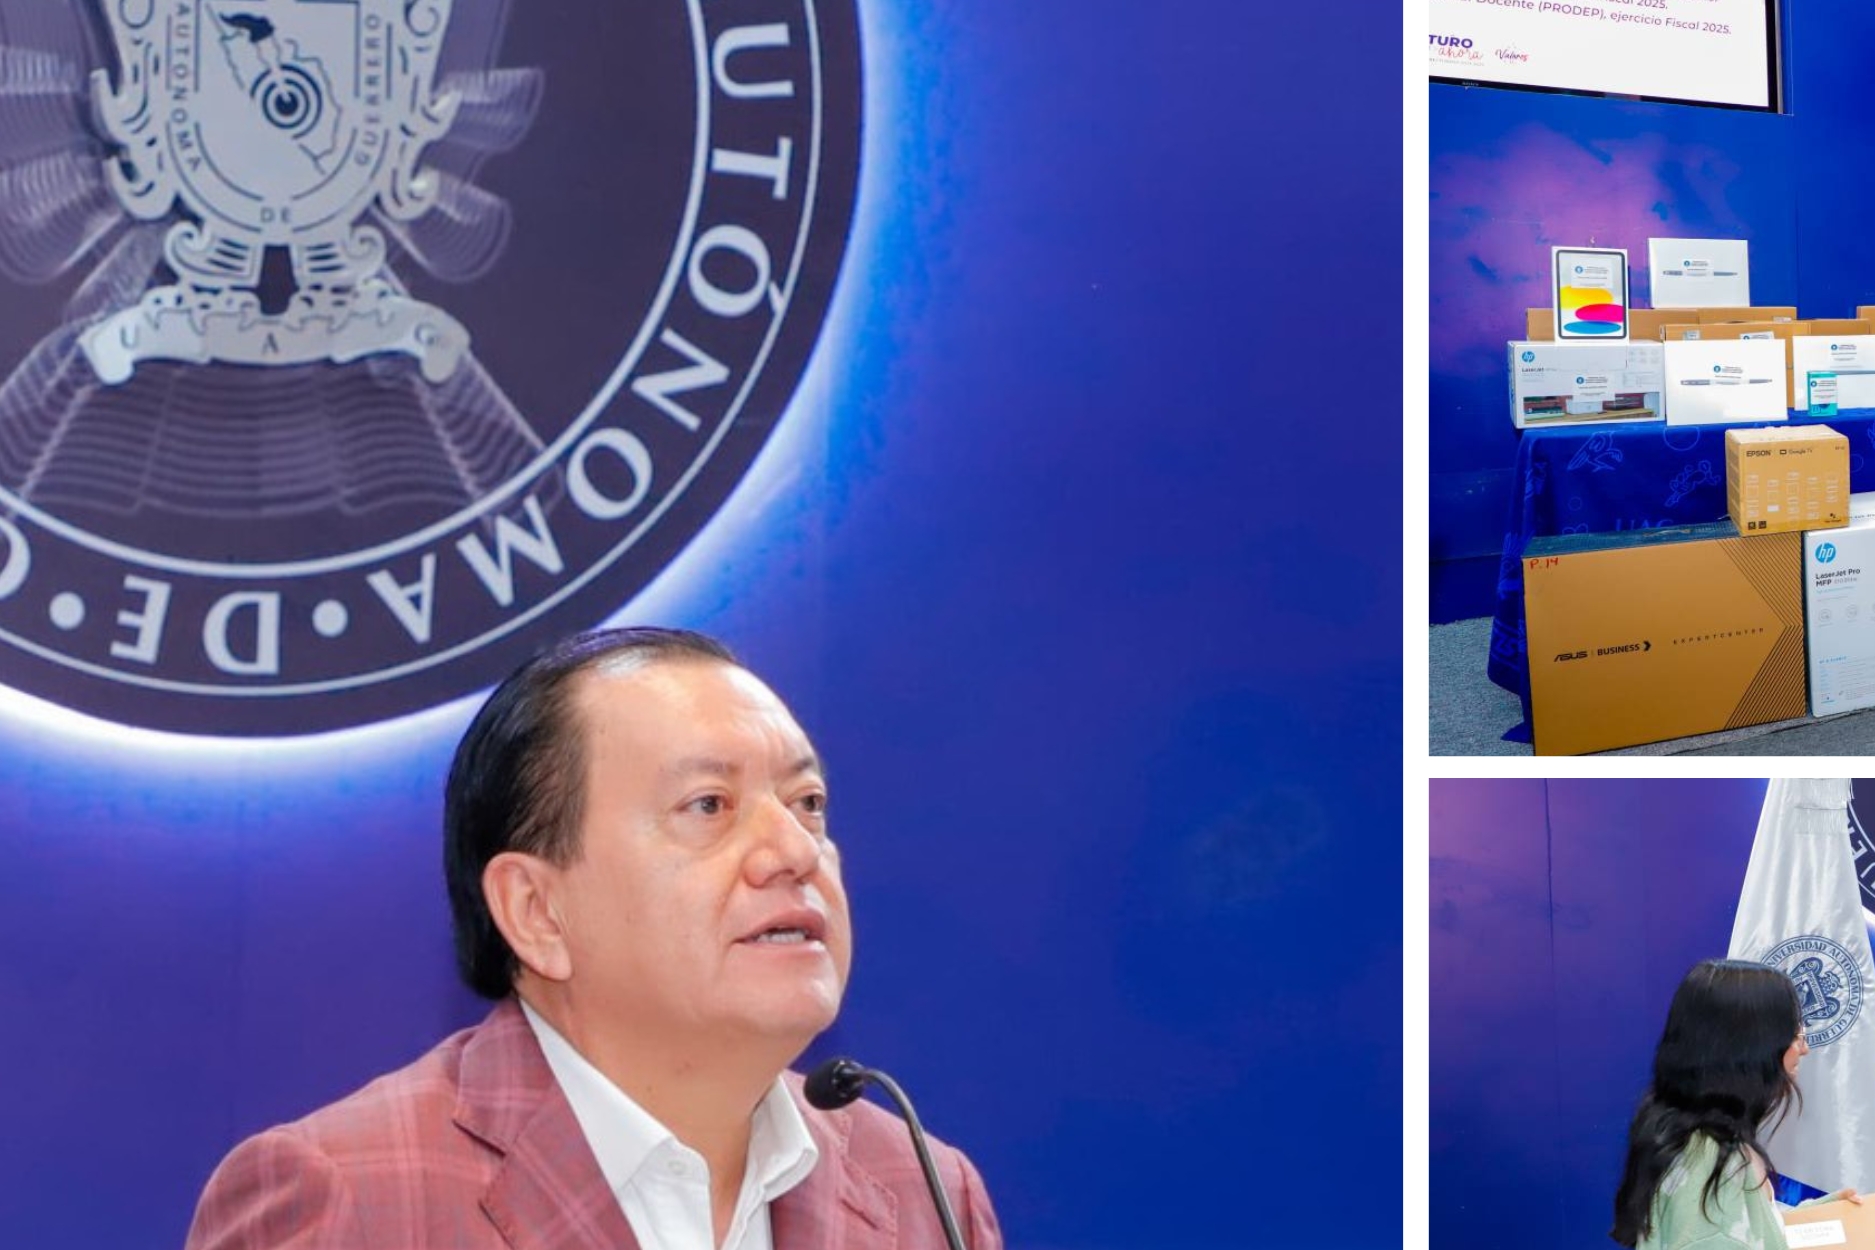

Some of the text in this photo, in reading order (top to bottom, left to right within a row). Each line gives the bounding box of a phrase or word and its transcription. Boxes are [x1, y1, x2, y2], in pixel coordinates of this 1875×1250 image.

[1610, 10, 1662, 26] ejercicio
[1665, 18, 1700, 30] Fiscal
[1702, 22, 1732, 35] 2025.
[1429, 34, 1473, 48] TURO
[260, 208, 292, 222] DE
[110, 23, 795, 675] UTÓNOMA DE
[121, 326, 279, 354] U A
[1815, 543, 1836, 563] hp
[1816, 570, 1846, 579] LaserJet
[1816, 579, 1831, 587] MFP
[1554, 651, 1588, 662] ASUS
[1597, 643, 1639, 656] BUSINESS
